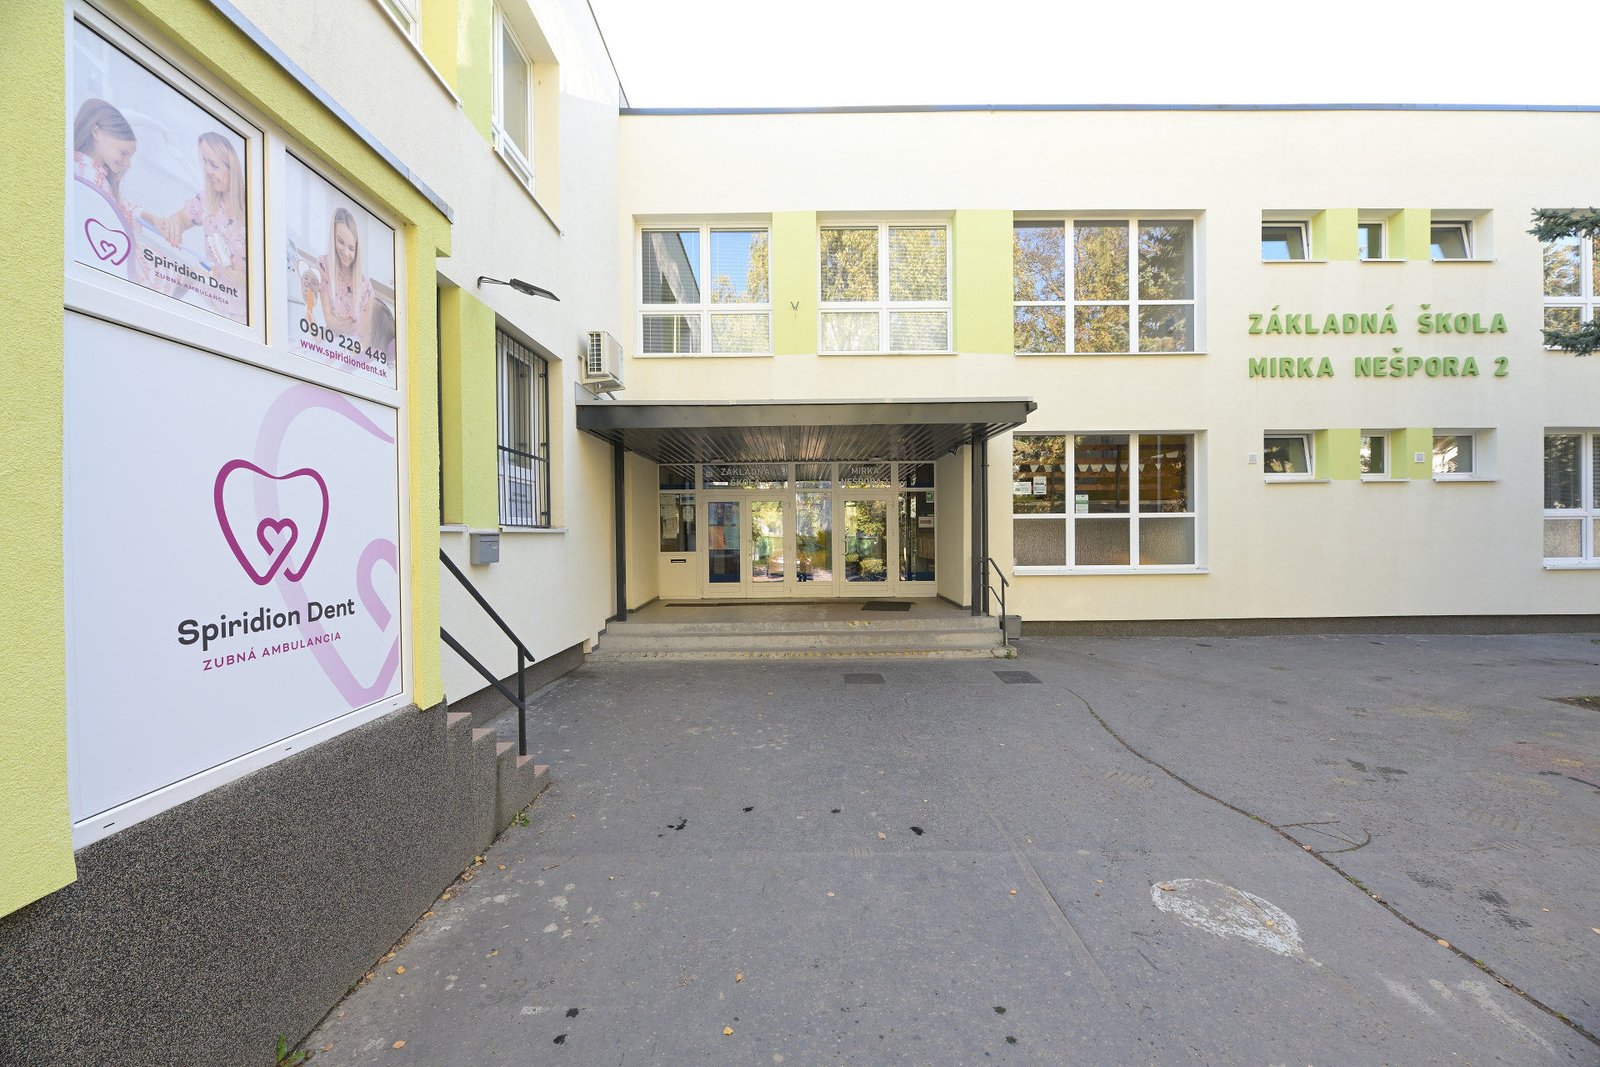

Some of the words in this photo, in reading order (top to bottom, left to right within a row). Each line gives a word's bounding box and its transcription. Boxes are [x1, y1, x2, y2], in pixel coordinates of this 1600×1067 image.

[143, 248, 206, 284] Spiridion
[209, 276, 239, 298] Dent
[154, 271, 182, 287] ZUBNÁ
[183, 283, 229, 305] AMBULANCIA
[1248, 304, 1398, 334] ZÁKLADNÁ
[1417, 303, 1508, 333] ŠKOLA
[299, 318, 334, 343] 0910
[338, 334, 361, 354] 229
[365, 346, 387, 364] 449
[300, 339, 387, 378] www.spiridiondent.sk
[1248, 356, 1335, 378] MIRKA
[1354, 347, 1480, 377] NEŠPORA
[1494, 356, 1509, 377] 2
[720, 465, 770, 476] ZÁKLADNÁ
[851, 466, 879, 475] MIRKA
[177, 606, 301, 651] Spiridion
[307, 598, 355, 623] Dent
[202, 646, 257, 671] ZUBNÁ
[261, 632, 342, 658] AMBULANCIA
